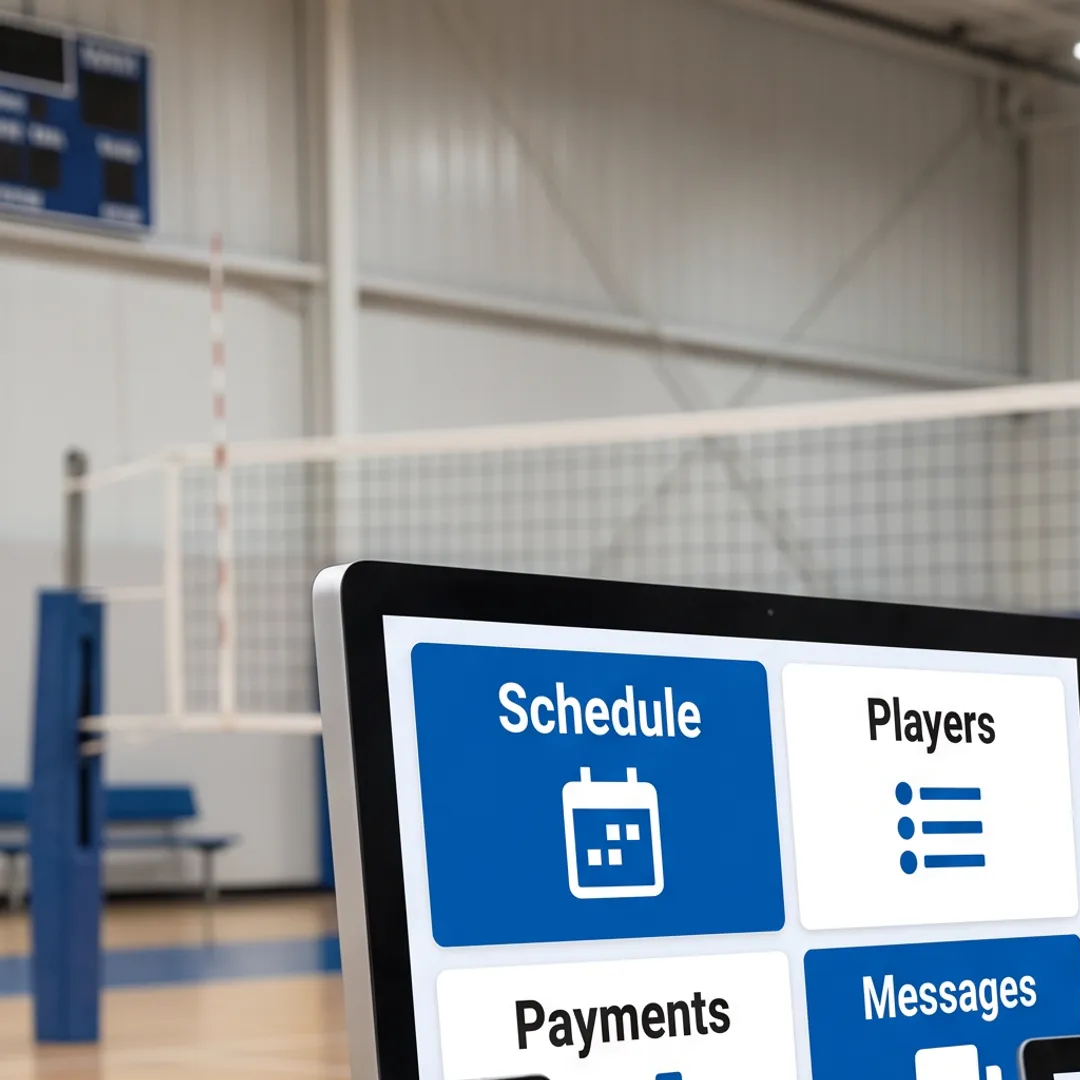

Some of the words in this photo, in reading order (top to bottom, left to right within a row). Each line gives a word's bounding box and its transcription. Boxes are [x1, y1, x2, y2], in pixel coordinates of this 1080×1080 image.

[498, 681, 702, 739] Schedule
[867, 696, 996, 755] Players
[515, 991, 731, 1059] Payments
[862, 974, 1037, 1022] Messages
